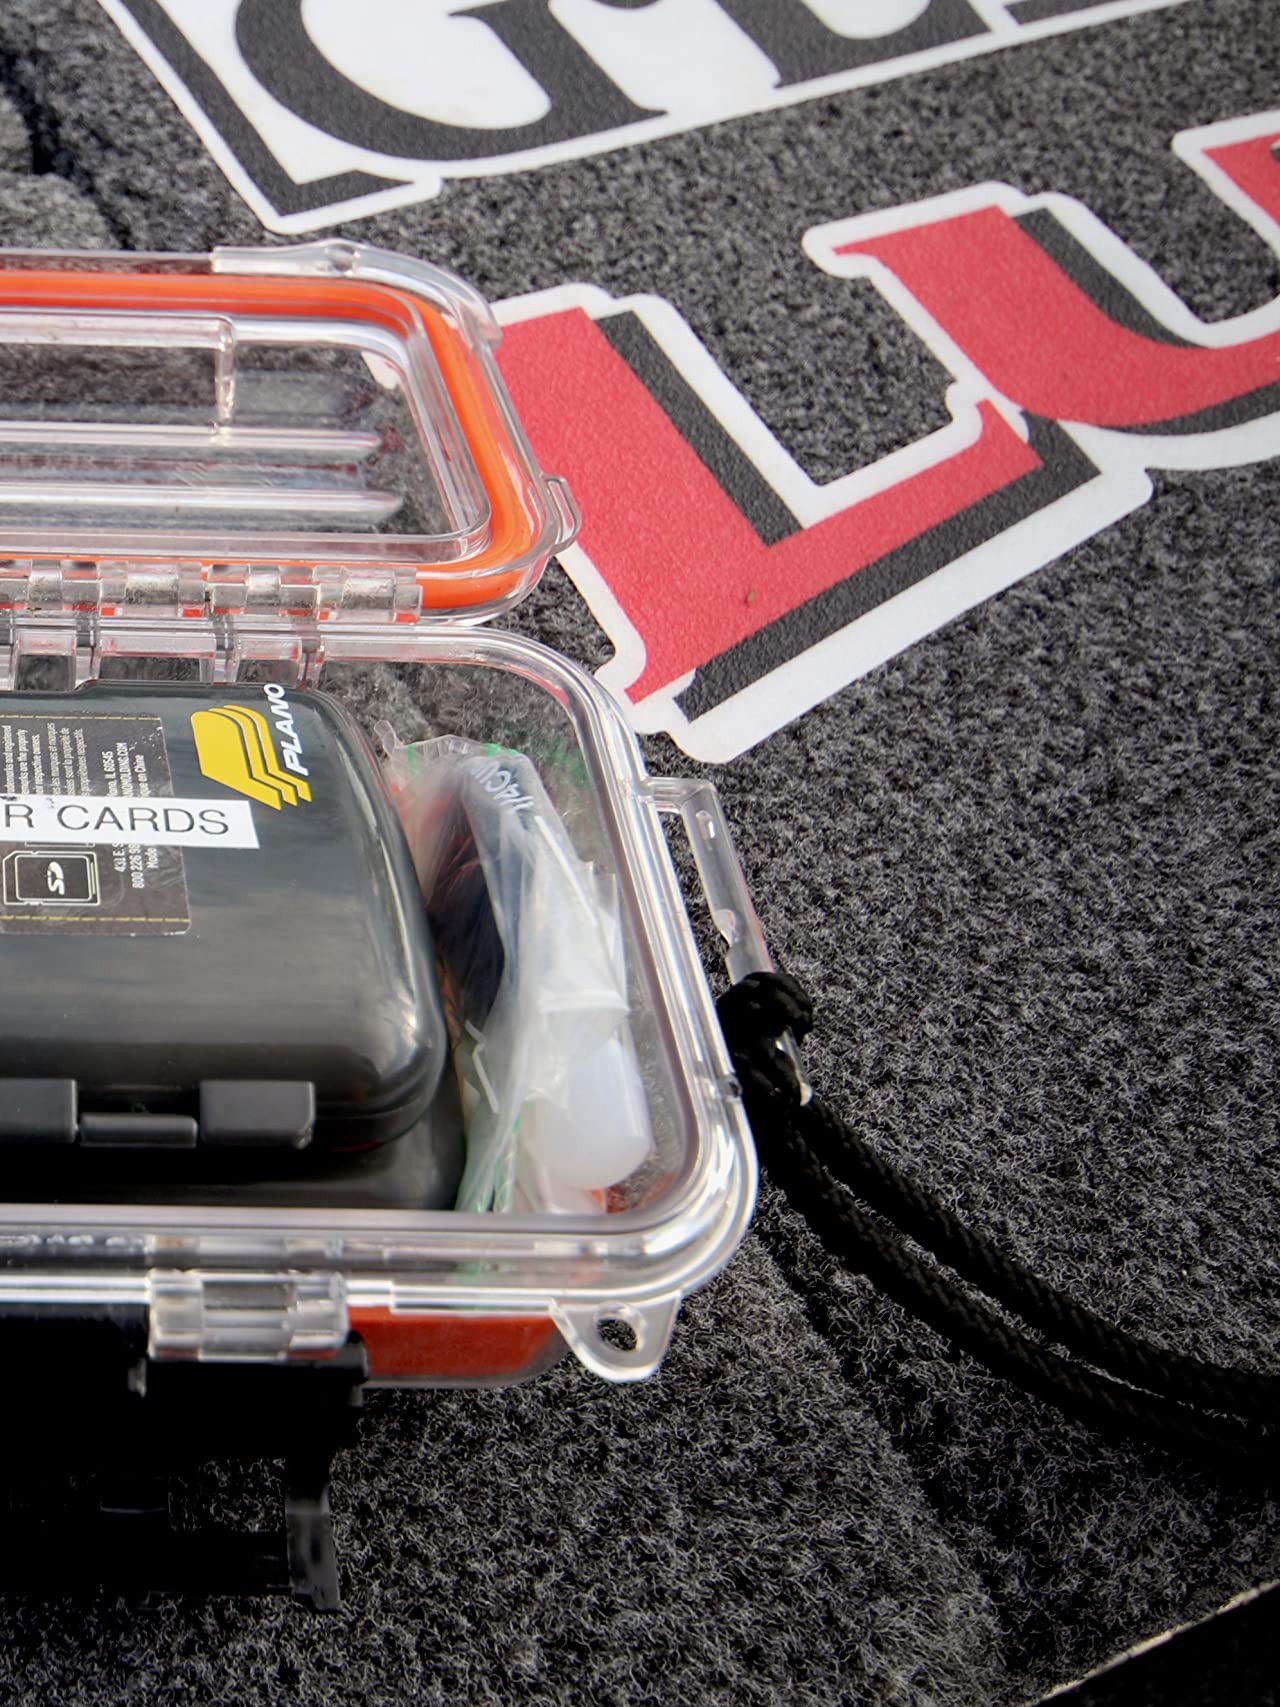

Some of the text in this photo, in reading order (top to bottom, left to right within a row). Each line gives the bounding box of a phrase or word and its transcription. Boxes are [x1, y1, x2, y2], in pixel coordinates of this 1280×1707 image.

[16, 729, 29, 752] property
[263, 683, 309, 777] PLANO
[2, 725, 15, 794] ademarks and registered
[17, 752, 28, 762] the
[31, 755, 45, 785] respective
[18, 772, 29, 795] emarks
[106, 779, 118, 797] lano,
[57, 804, 229, 835] CARDS
